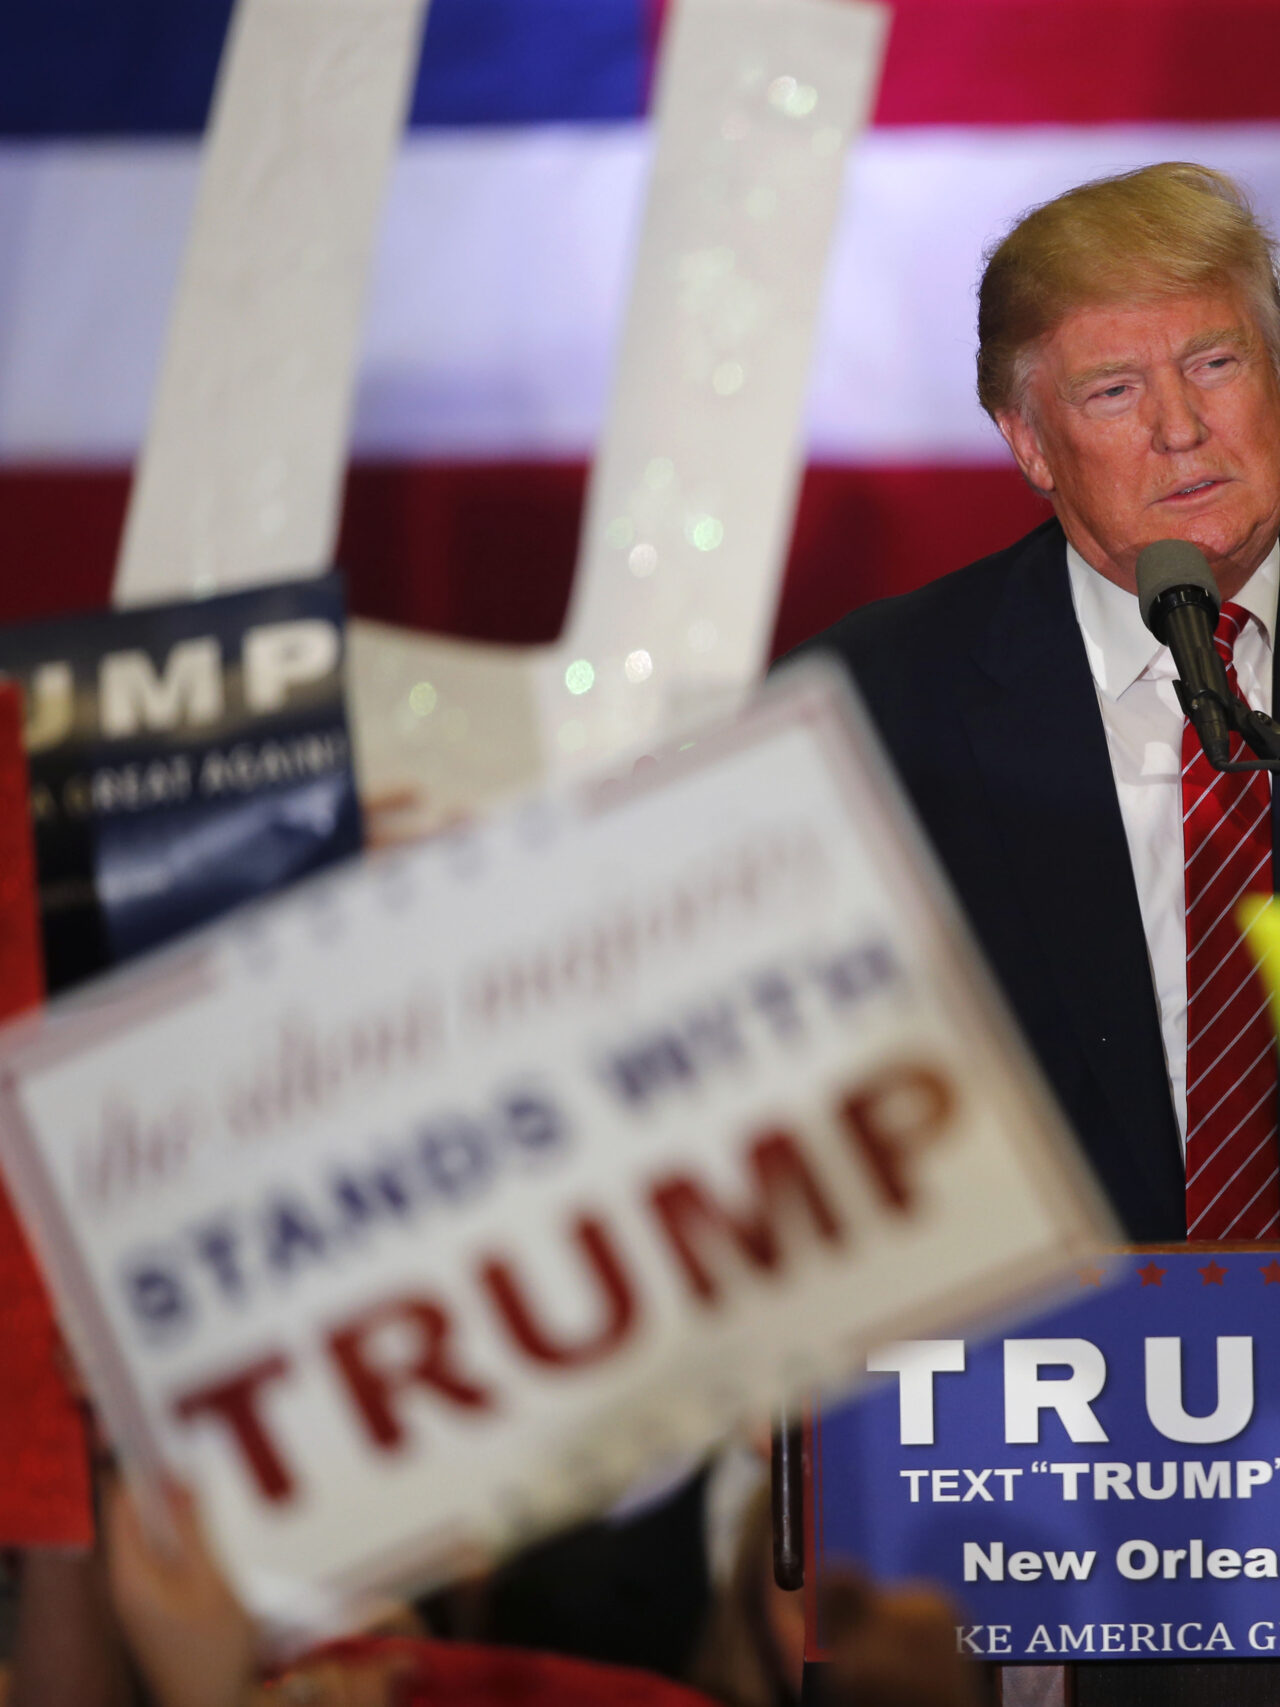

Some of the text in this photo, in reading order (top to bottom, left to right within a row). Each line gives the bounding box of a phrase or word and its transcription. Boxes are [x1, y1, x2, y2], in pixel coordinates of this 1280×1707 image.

[122, 1078, 574, 1328] STANDS
[168, 1055, 962, 1512] TRUMP
[900, 1469, 1024, 1502] TEXT
[963, 1541, 1097, 1582] New
[955, 1624, 1013, 1654] KE
[1025, 1621, 1236, 1654] AMERICA
